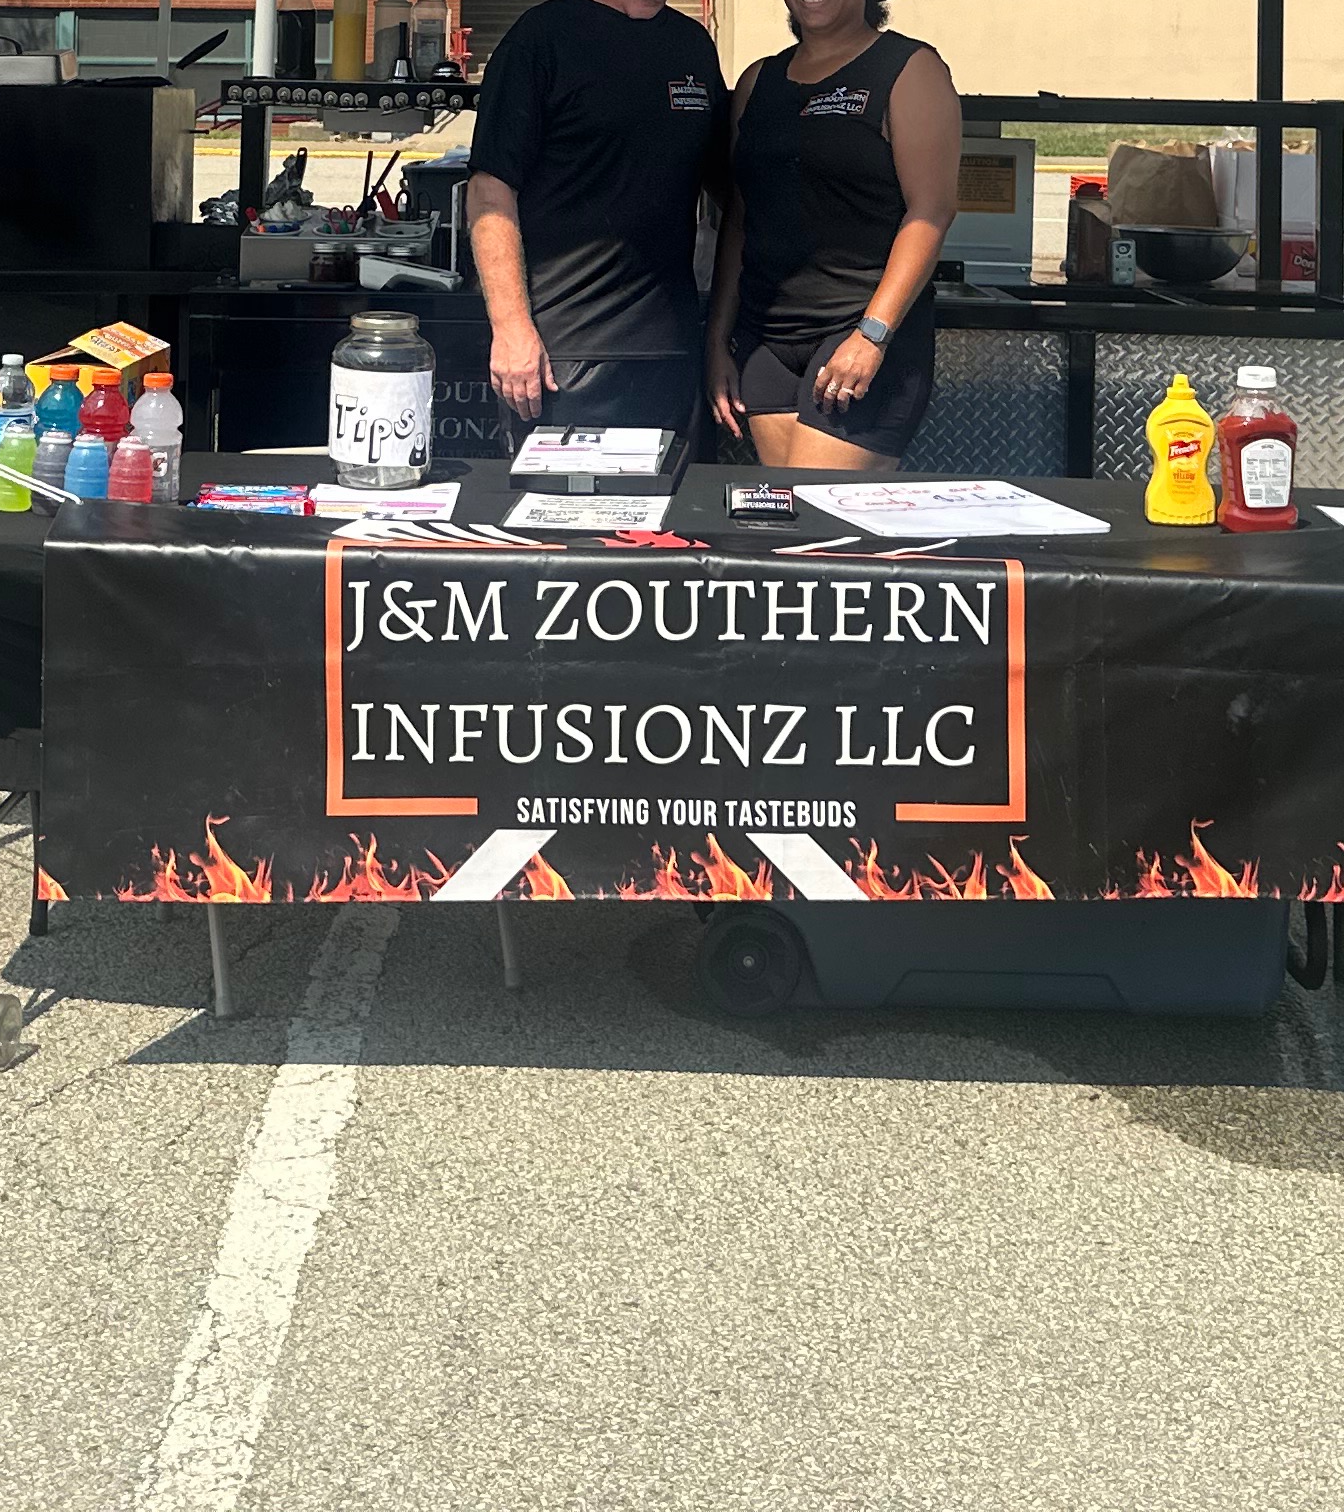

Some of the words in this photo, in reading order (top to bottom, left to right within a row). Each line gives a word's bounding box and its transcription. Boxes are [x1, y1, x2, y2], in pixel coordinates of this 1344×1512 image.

[961, 157, 1000, 166] AUTION
[346, 580, 510, 652] J&M
[534, 579, 998, 646] ZOUTHERN
[351, 702, 808, 768] INFUSIONZ
[834, 704, 976, 768] LLC
[516, 797, 649, 825] SATISFYING
[657, 798, 717, 827] YOUR
[724, 799, 857, 828] TASTEBUDS
